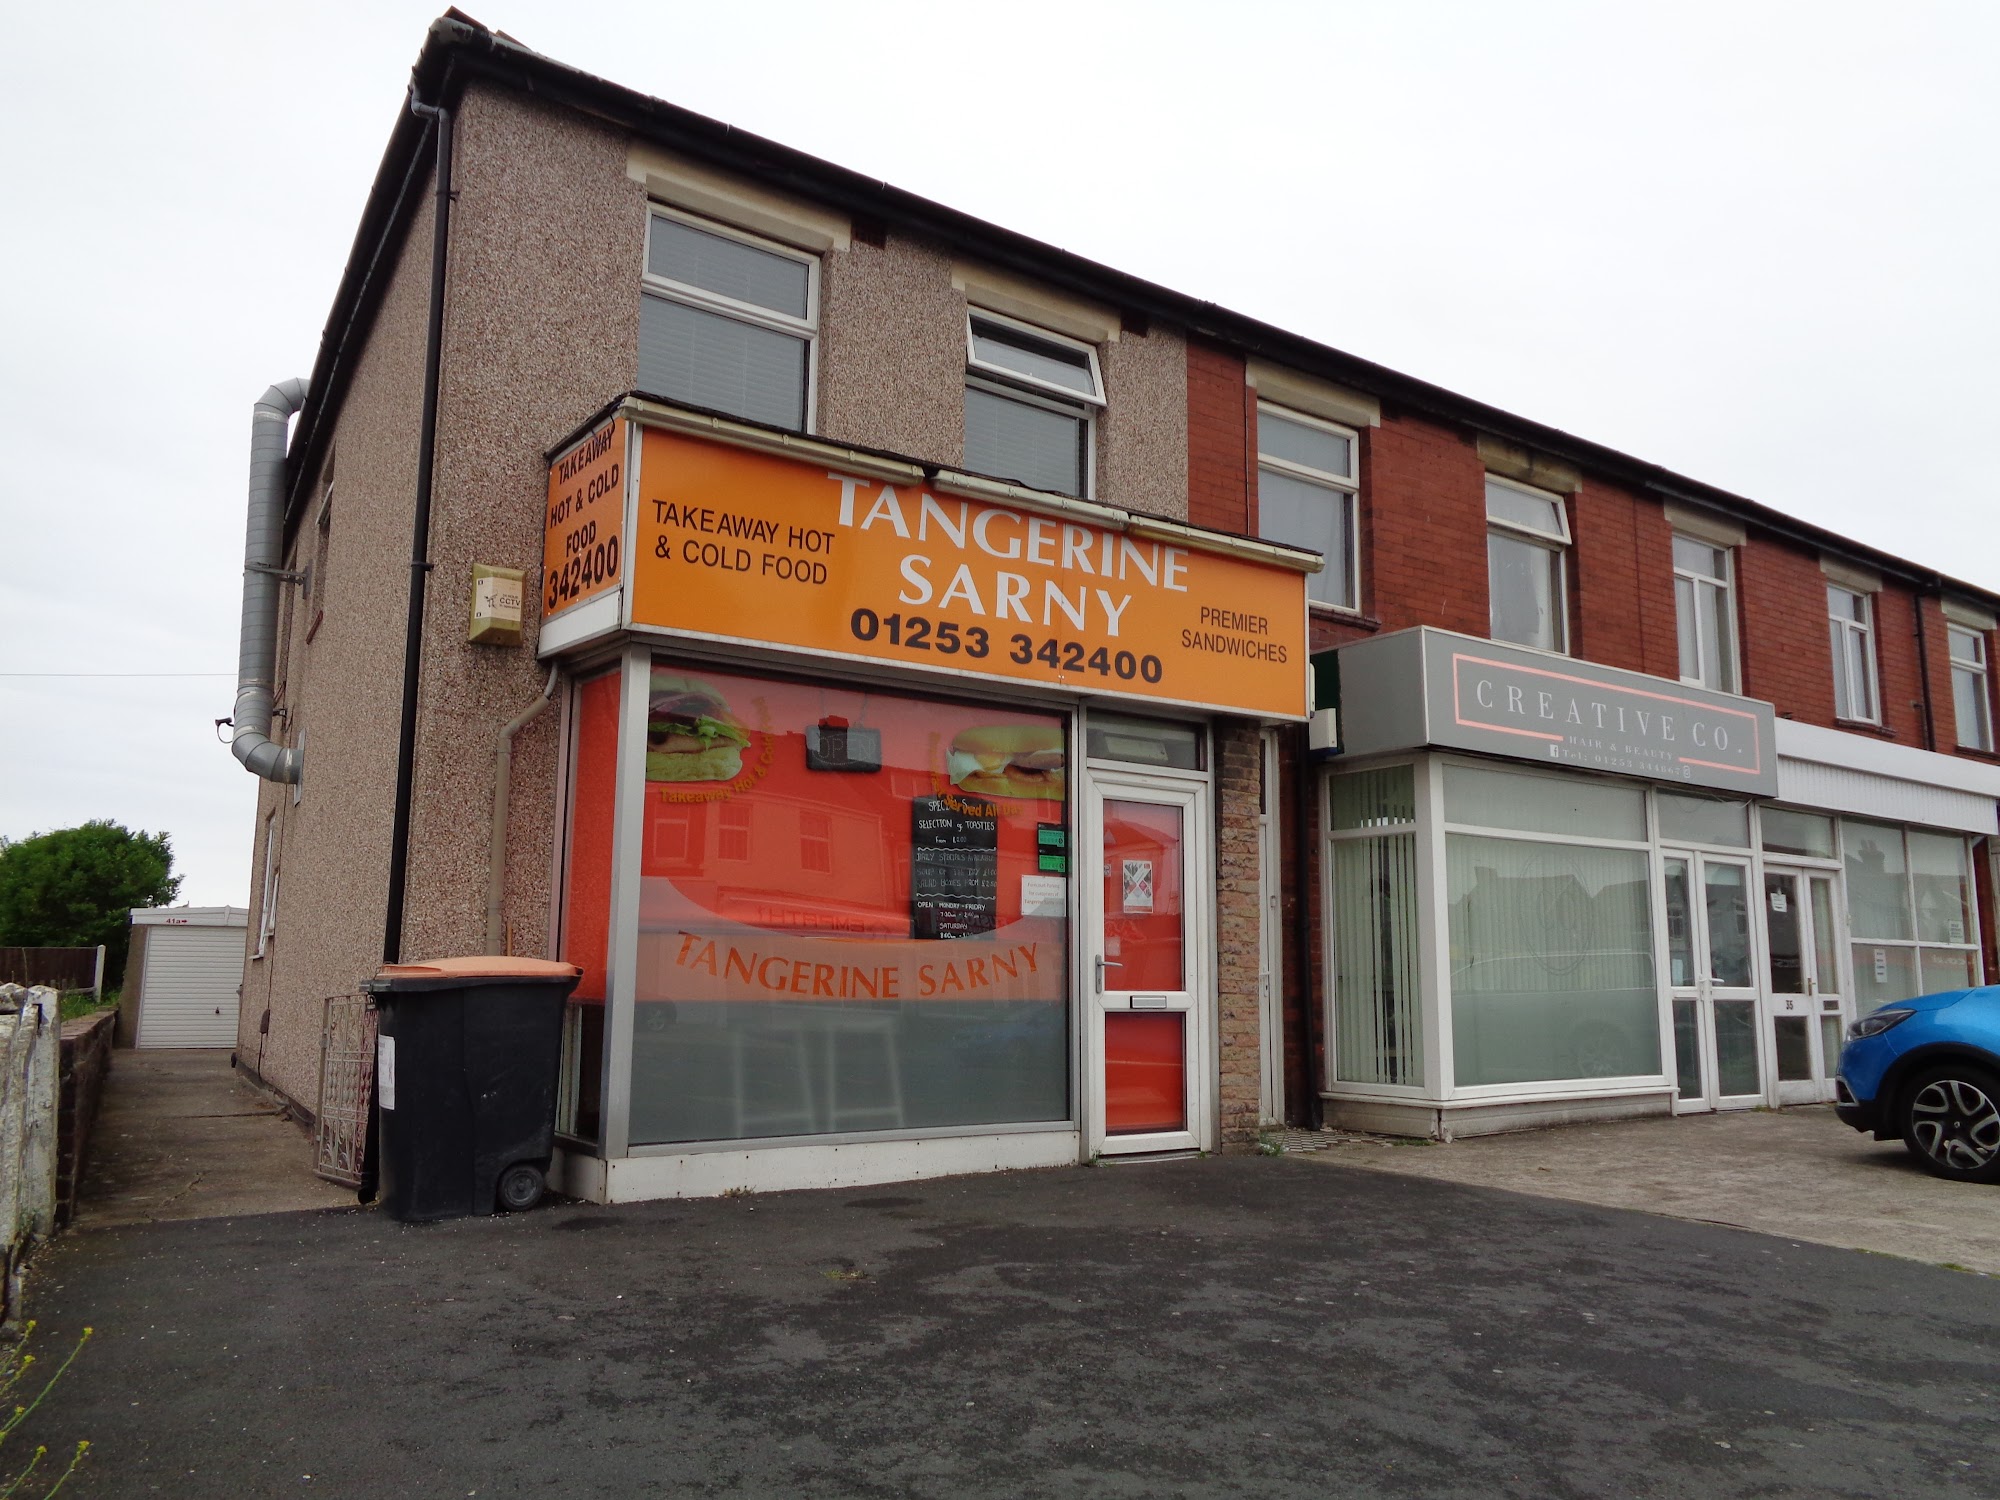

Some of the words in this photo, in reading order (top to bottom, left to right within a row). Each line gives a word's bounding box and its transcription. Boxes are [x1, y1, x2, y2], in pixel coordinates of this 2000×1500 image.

[558, 426, 614, 486] TAKEAWAY
[550, 495, 572, 529] HOT
[575, 489, 584, 513] &
[588, 463, 620, 504] COLD
[565, 519, 597, 558] FOOD
[652, 499, 780, 545] TAKEAWAY
[788, 525, 836, 555] HOT
[827, 471, 1190, 593] TANGERINE
[548, 534, 619, 610] 342400
[654, 534, 671, 560] &
[682, 539, 752, 573] COLD
[762, 553, 828, 585] FOOD
[499, 597, 521, 606] CCTV
[898, 553, 1132, 637] SARNY
[1200, 605, 1269, 636] PREMIER
[850, 607, 990, 659] 01253
[1009, 633, 1163, 684] 342400
[1181, 629, 1288, 664] SANDWICHES
[1476, 679, 1676, 742] CREATIVE
[1692, 721, 1743, 754] CO.
[1569, 735, 1602, 749] HAIR
[1610, 743, 1617, 752] &
[1625, 744, 1673, 761] BEAUTY
[1594, 755, 1633, 768] 01253
[661, 787, 731, 803] Takeaway
[918, 819, 953, 830] SELECTION
[964, 820, 995, 831] TOASTIES
[917, 901, 934, 909] OPEN
[964, 903, 986, 911] FRIDAY
[939, 922, 968, 930] SATURDAY
[675, 929, 899, 999] TANGERINE
[918, 942, 1038, 997] SARNY
[1785, 999, 1794, 1011] 35
